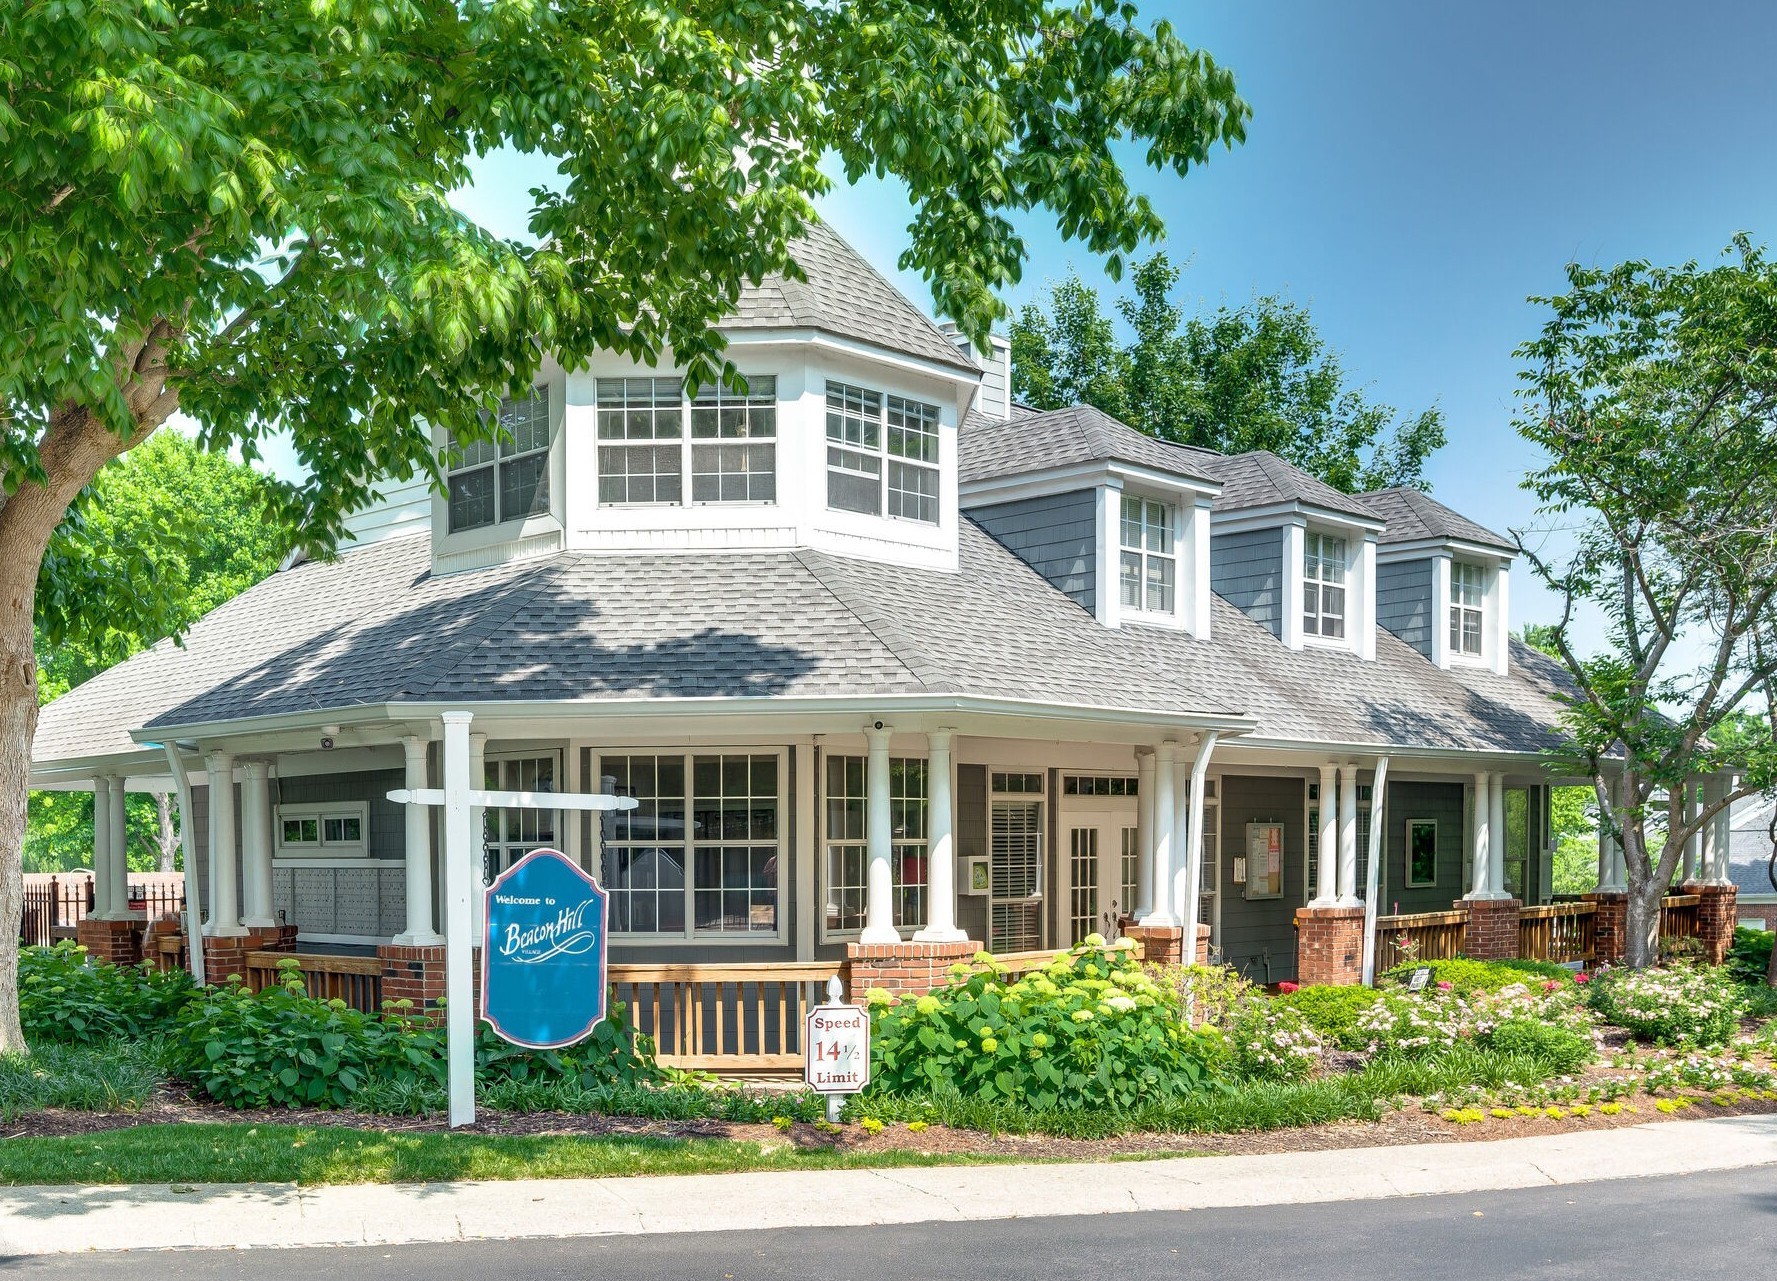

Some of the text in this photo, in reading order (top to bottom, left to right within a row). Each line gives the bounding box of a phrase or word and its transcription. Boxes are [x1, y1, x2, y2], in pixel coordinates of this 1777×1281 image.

[495, 894, 556, 906] Welcome to
[499, 898, 594, 956] Beacon Hill
[814, 1017, 861, 1032] Speed
[816, 1071, 859, 1084] Limit
